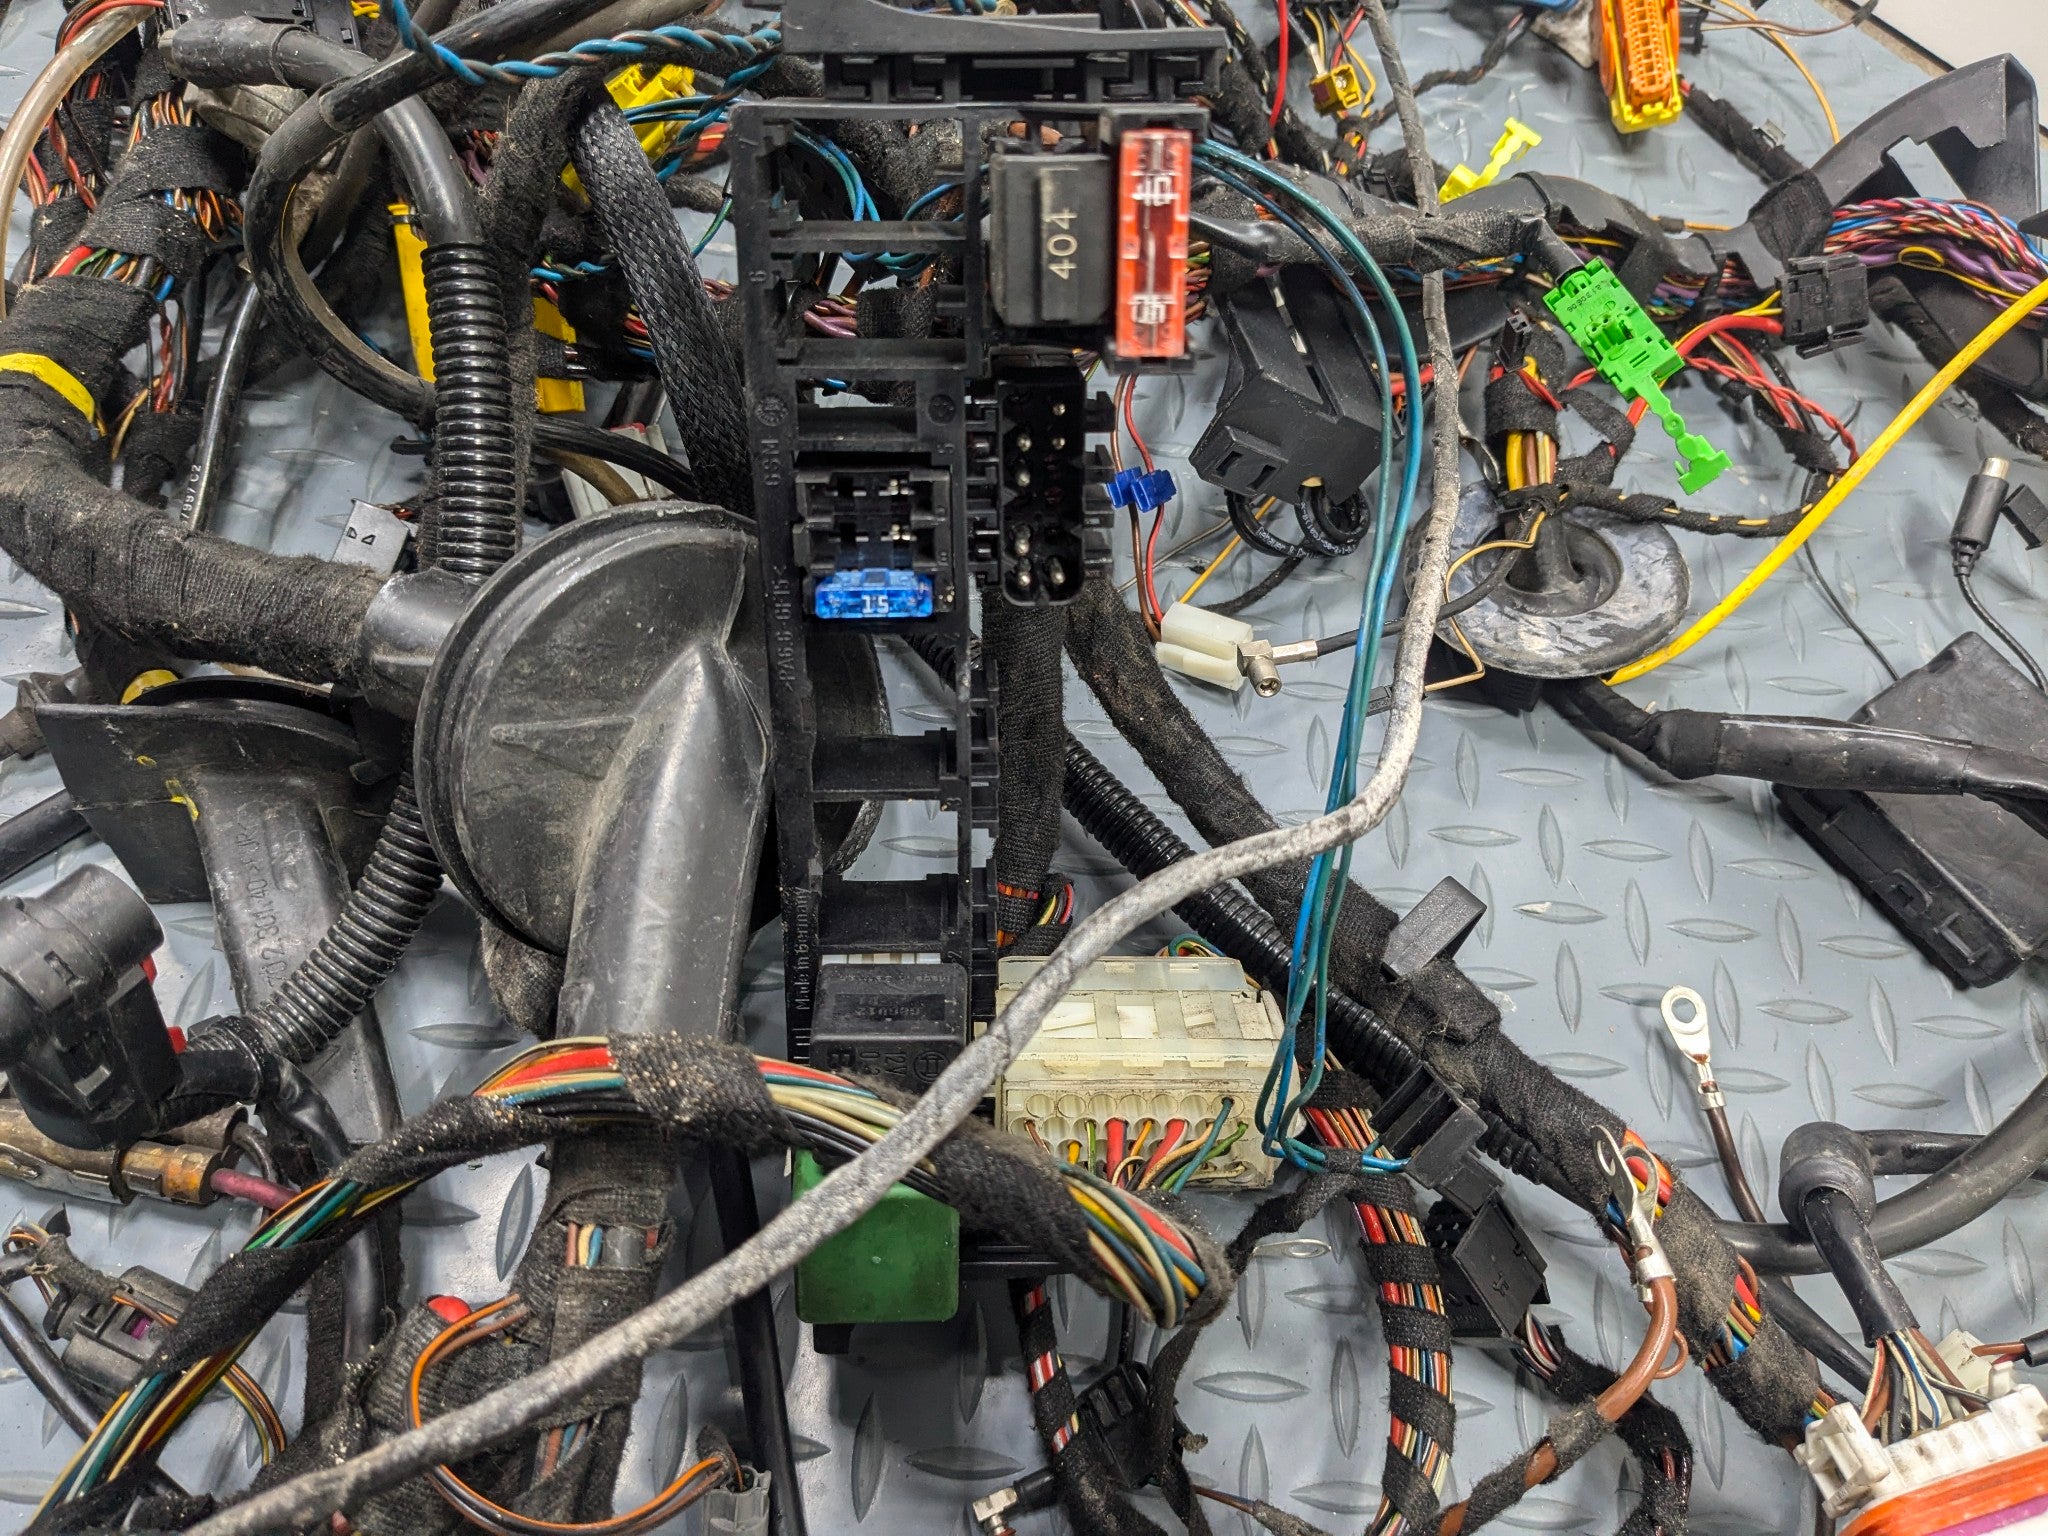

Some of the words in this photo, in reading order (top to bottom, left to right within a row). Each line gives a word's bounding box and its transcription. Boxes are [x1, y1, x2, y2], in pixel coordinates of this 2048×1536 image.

[1134, 175, 1174, 206] 40
[1042, 208, 1078, 280] 404
[761, 438, 781, 486] GSM
[861, 595, 889, 614] 15
[791, 887, 812, 954] Germany
[792, 972, 811, 1010] Made
